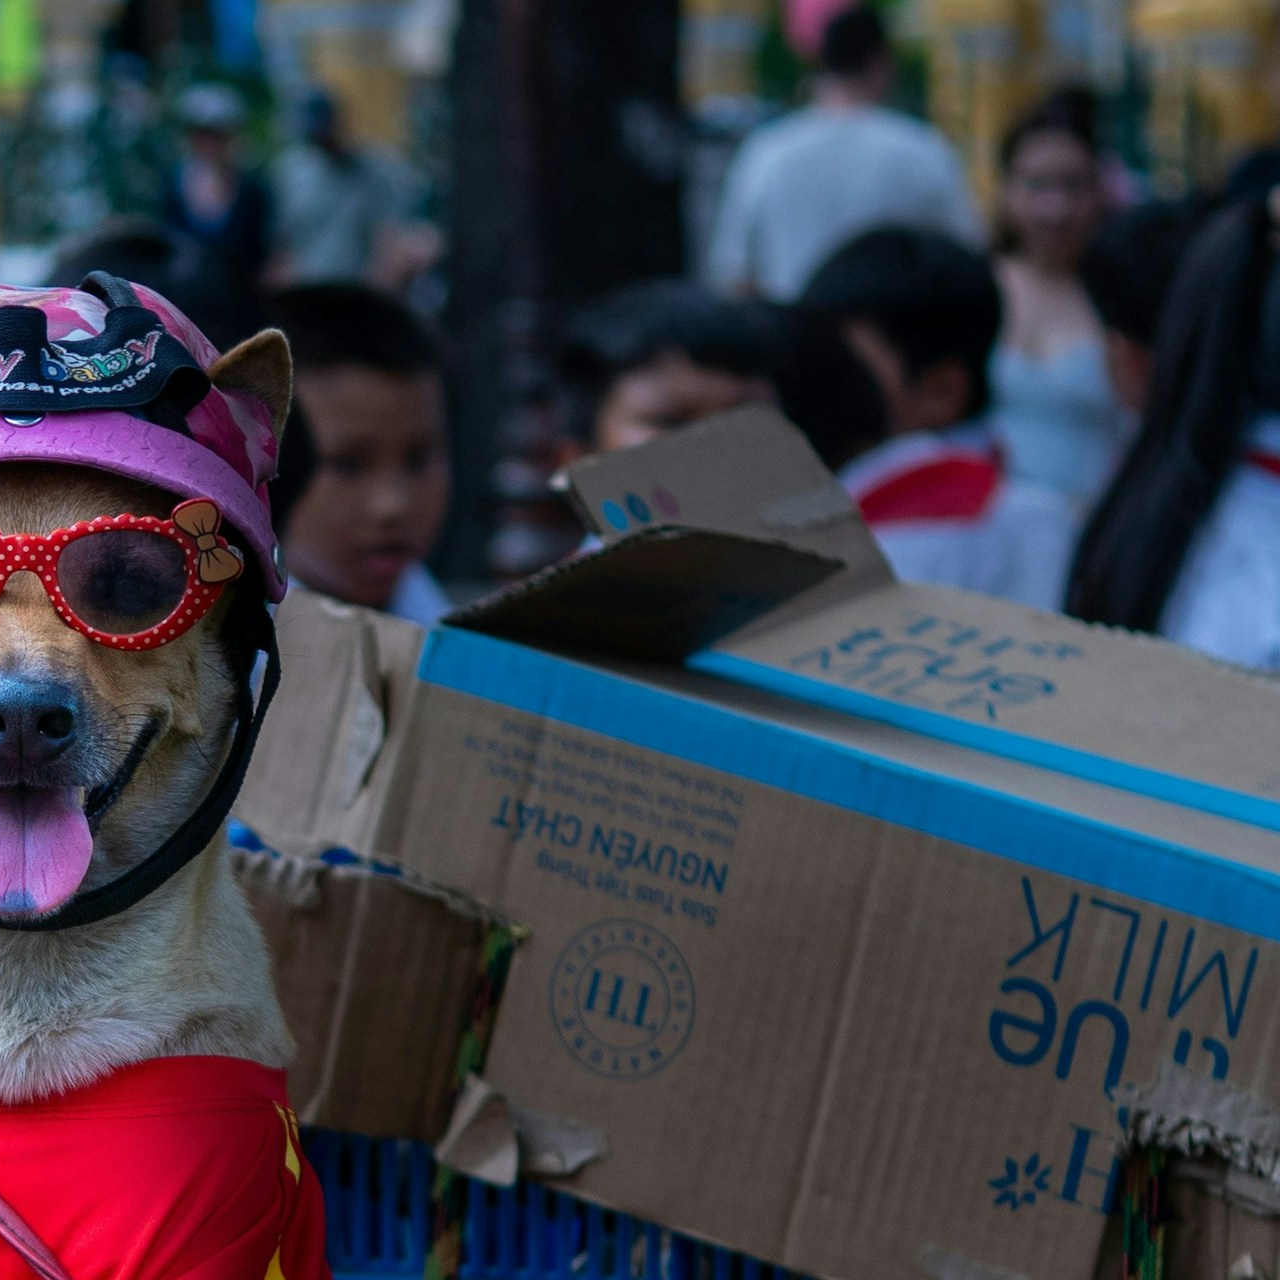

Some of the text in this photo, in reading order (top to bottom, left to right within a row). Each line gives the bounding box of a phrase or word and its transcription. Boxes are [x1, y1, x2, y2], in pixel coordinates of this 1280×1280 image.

[40, 330, 162, 382] baby
[59, 362, 156, 396] protection
[1007, 875, 1259, 1040] MILK
